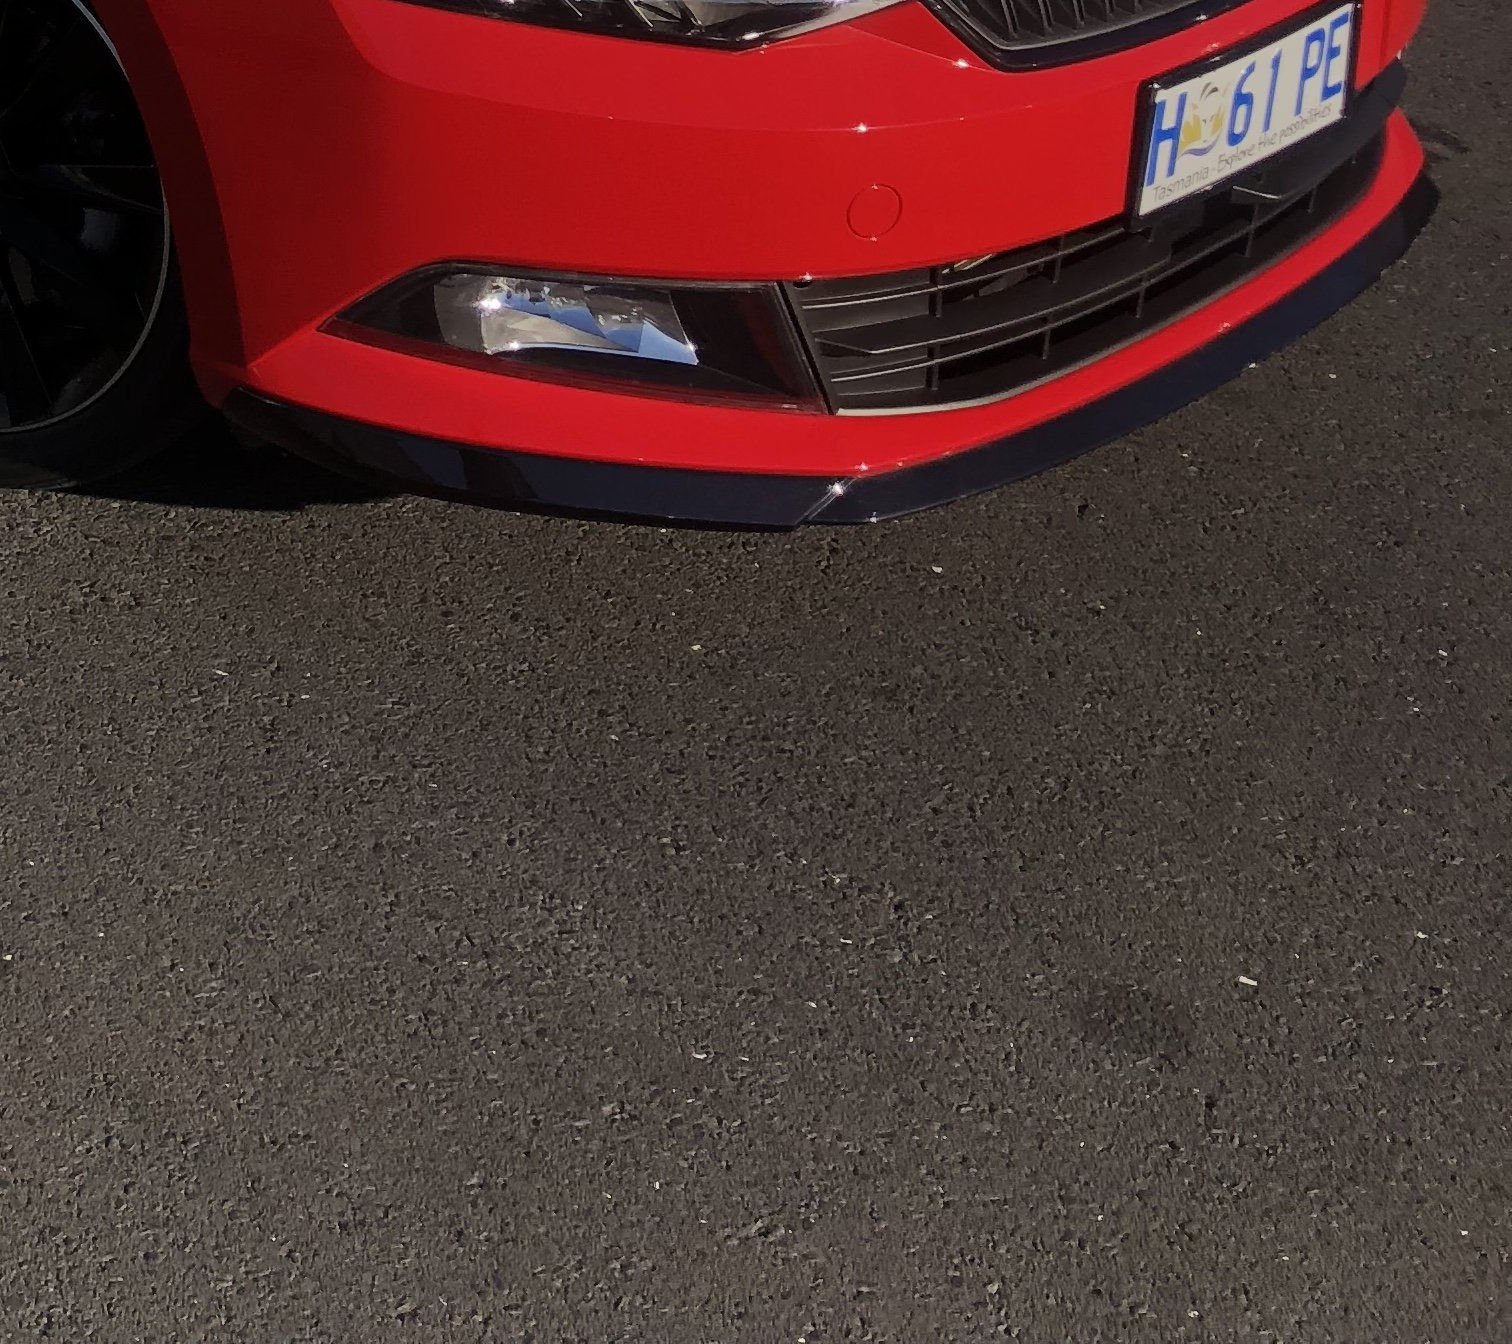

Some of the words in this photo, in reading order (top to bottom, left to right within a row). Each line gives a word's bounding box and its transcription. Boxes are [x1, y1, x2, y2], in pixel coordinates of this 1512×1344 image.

[1145, 91, 1188, 187] H
[1226, 48, 1283, 147] 61
[1294, 12, 1351, 117] PE
[1152, 165, 1210, 203] Tasmania
[1216, 139, 1256, 174] Explore
[1257, 131, 1277, 152] the
